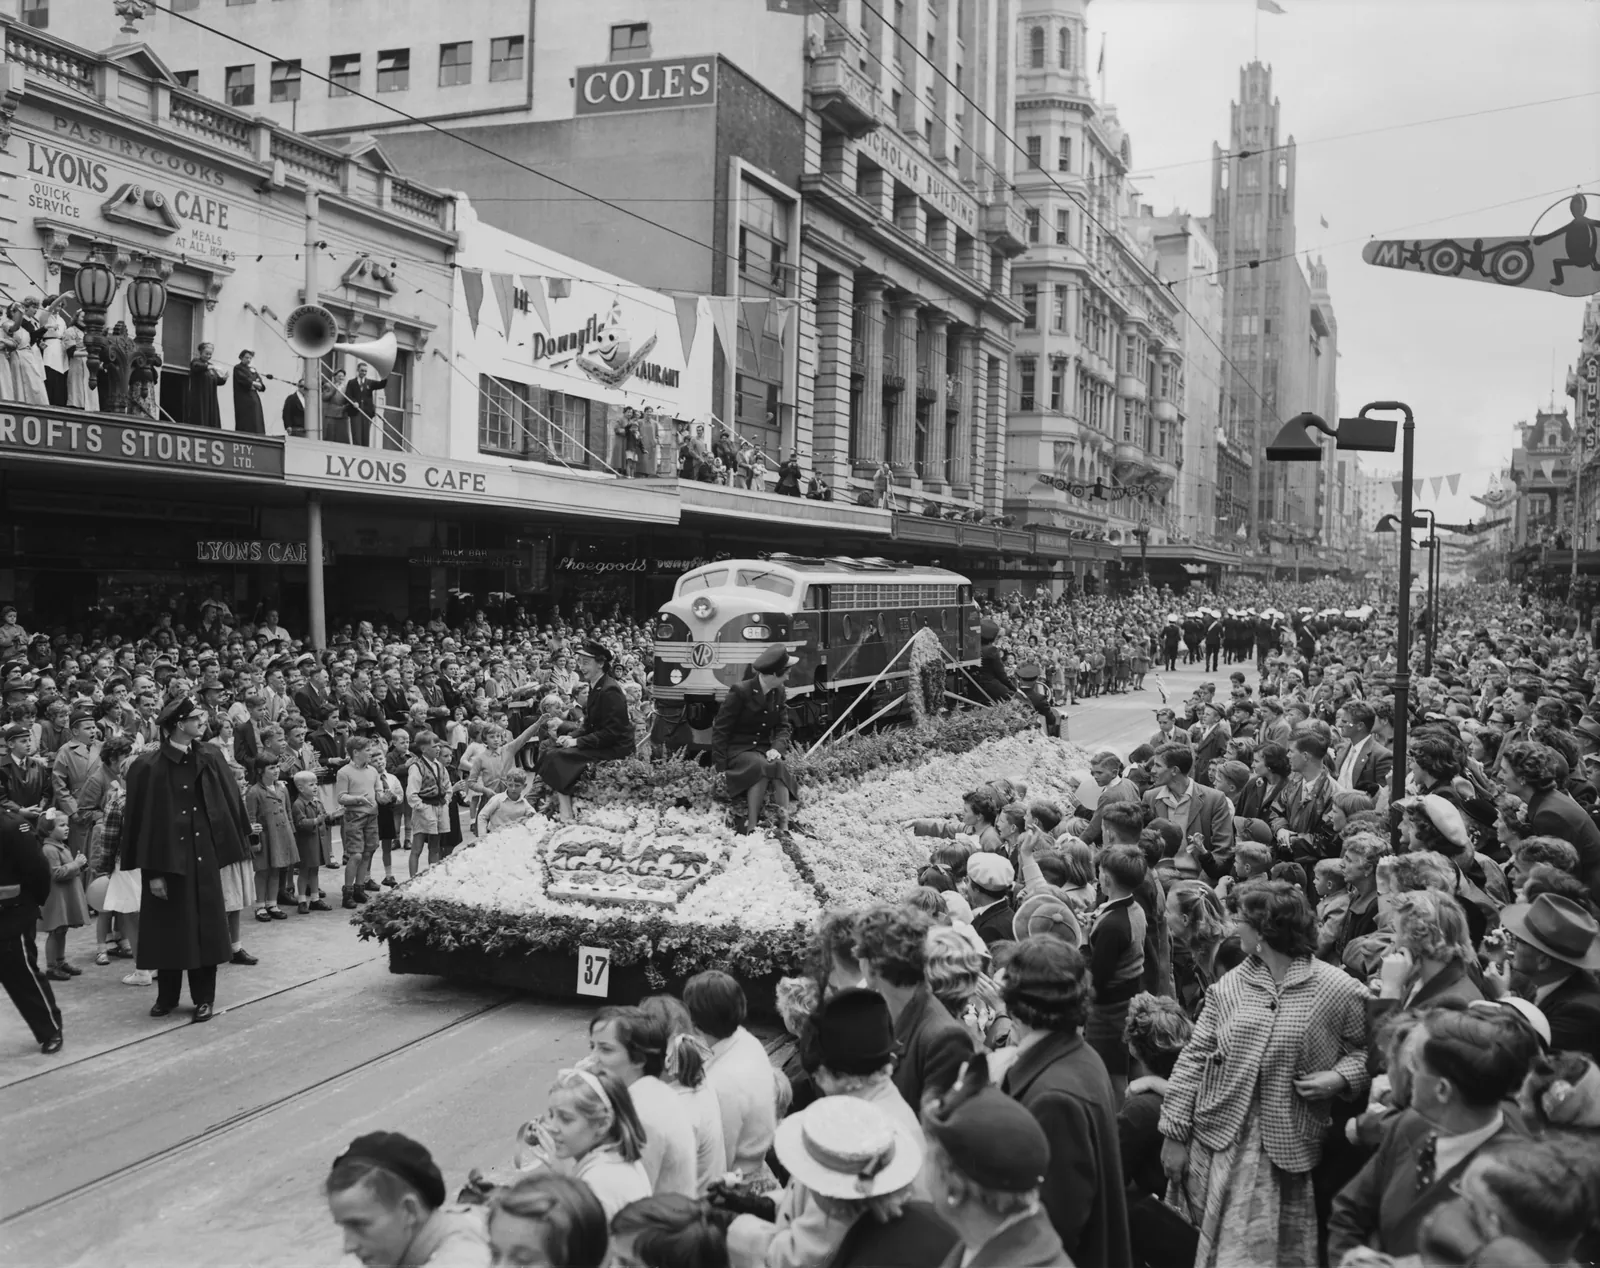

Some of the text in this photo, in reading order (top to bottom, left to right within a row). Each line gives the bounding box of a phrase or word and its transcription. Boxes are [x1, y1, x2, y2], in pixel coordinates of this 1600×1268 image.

[584, 63, 710, 104] COLES
[53, 116, 225, 187] PASTRYCOOKS
[27, 142, 229, 230] LYONS CAFE
[33, 183, 71, 203] QUICK
[28, 196, 80, 218] SERVICE
[927, 175, 974, 226] BUILDING
[175, 236, 236, 262] AT ALL HOURS
[191, 229, 222, 247] MEALS
[512, 285, 533, 316] HE
[121, 429, 226, 466] STORES
[232, 443, 254, 456] PTY.
[232, 457, 255, 469] LTD.
[326, 454, 486, 492] LYONS CAFE
[196, 541, 326, 562] LYONS CAF
[555, 556, 647, 574] Shoegoods
[693, 644, 712, 666] VR
[584, 954, 608, 986] 37
